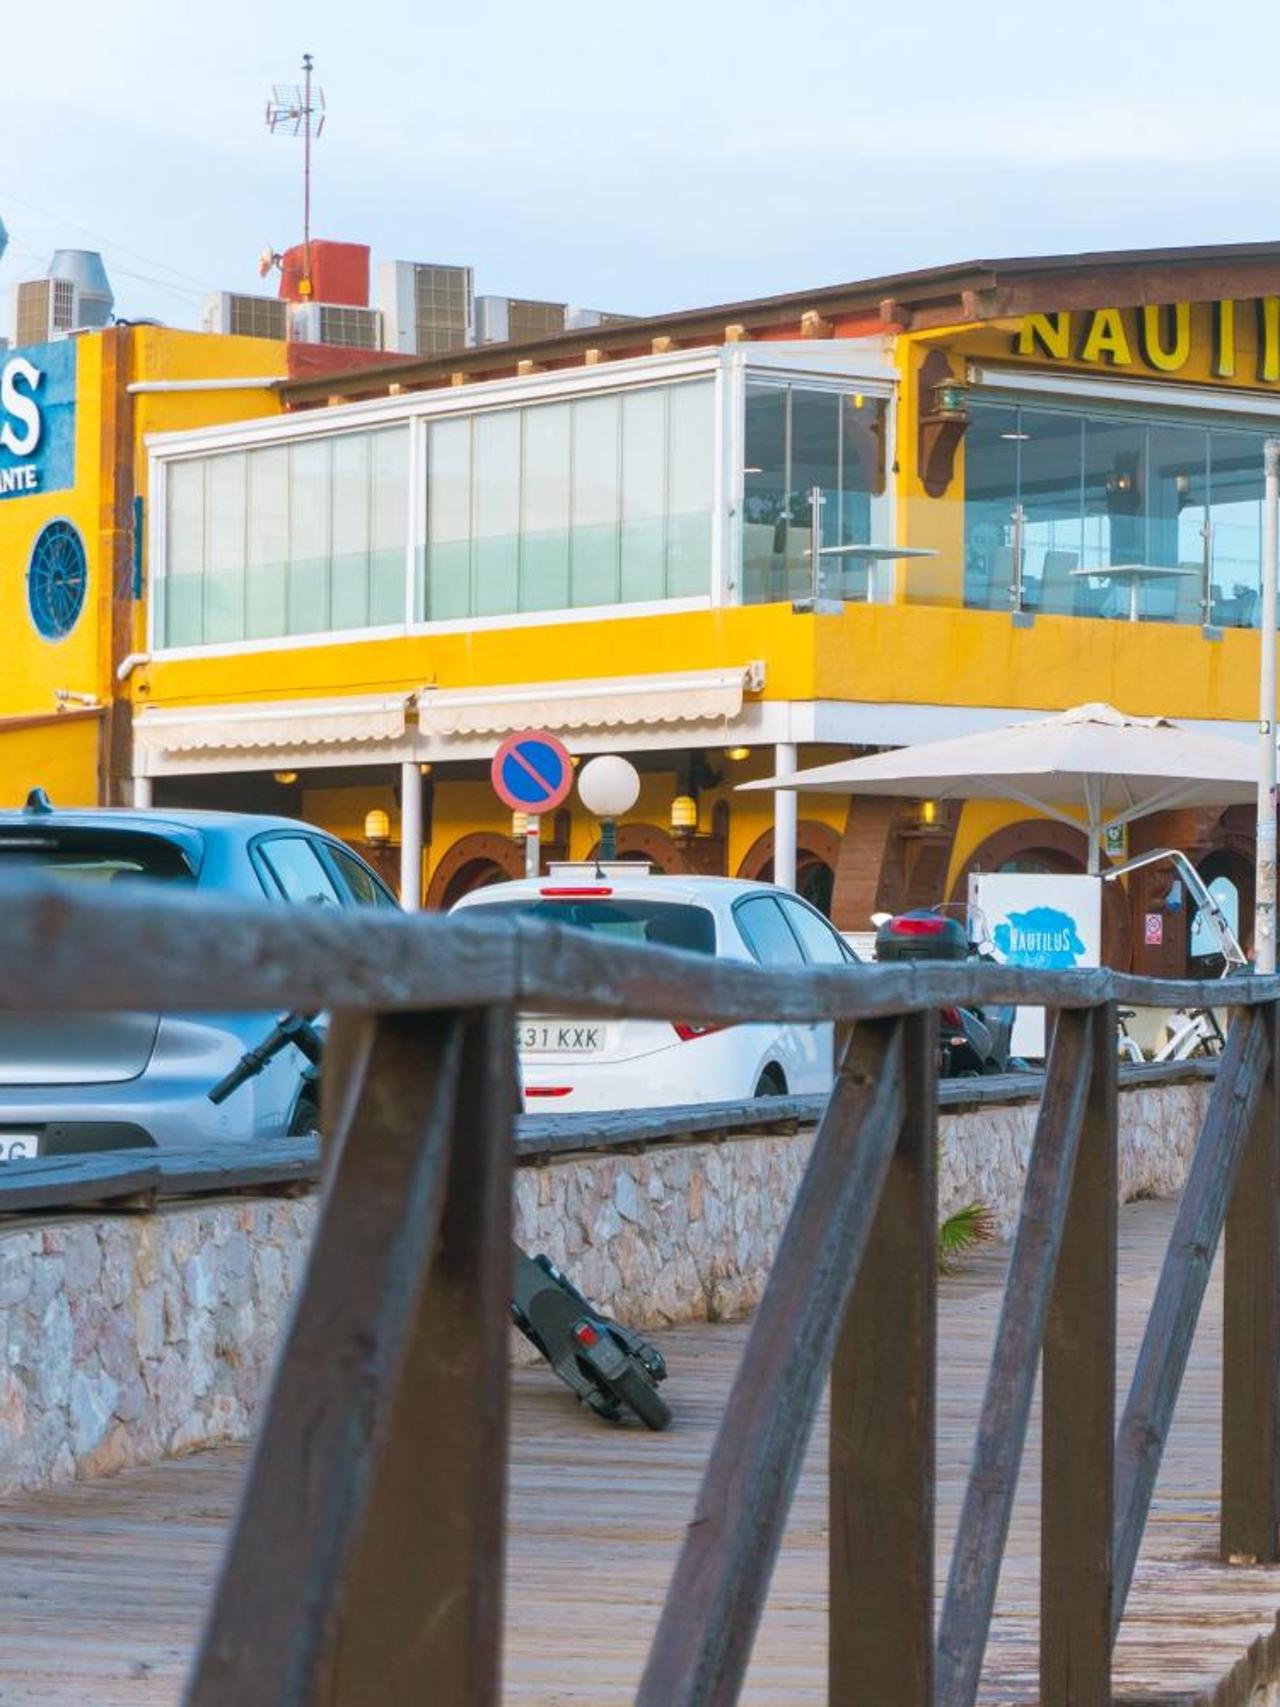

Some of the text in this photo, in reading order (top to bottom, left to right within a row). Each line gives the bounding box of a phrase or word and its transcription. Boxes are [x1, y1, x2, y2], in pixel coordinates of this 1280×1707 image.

[2, 357, 41, 456] S
[1010, 928, 1070, 951] NAUTILUS
[557, 1028, 598, 1048] KXK
